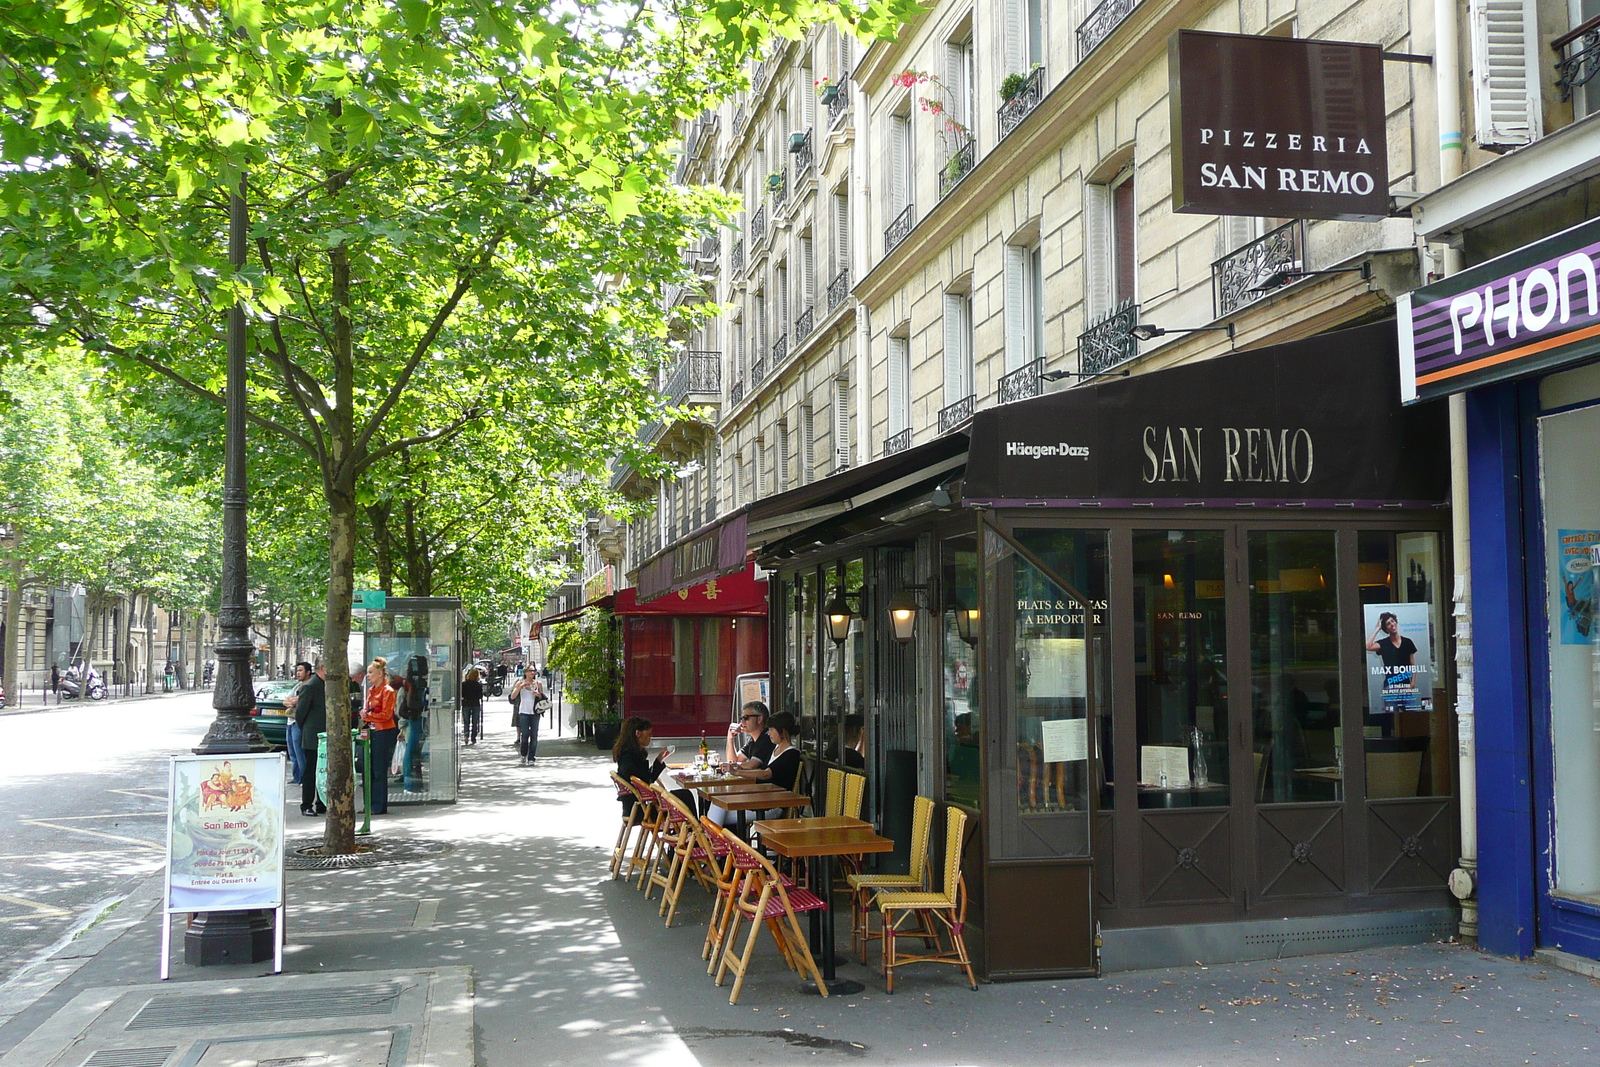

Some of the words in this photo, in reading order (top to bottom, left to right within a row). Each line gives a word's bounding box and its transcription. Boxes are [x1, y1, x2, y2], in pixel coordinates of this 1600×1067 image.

[1200, 128, 1371, 154] PIZZERIA
[1200, 162, 1268, 190] SAN
[1276, 167, 1375, 196] REMO
[1142, 426, 1202, 483] SAN
[1221, 427, 1314, 484] REMO
[1017, 600, 1051, 610] PLATS
[1055, 600, 1064, 610] &
[1036, 614, 1101, 624] EMPORTR
[1371, 666, 1392, 675] MAX
[1393, 665, 1427, 674] BOUBLIL
[204, 822, 220, 830] San
[224, 821, 248, 829] Remo
